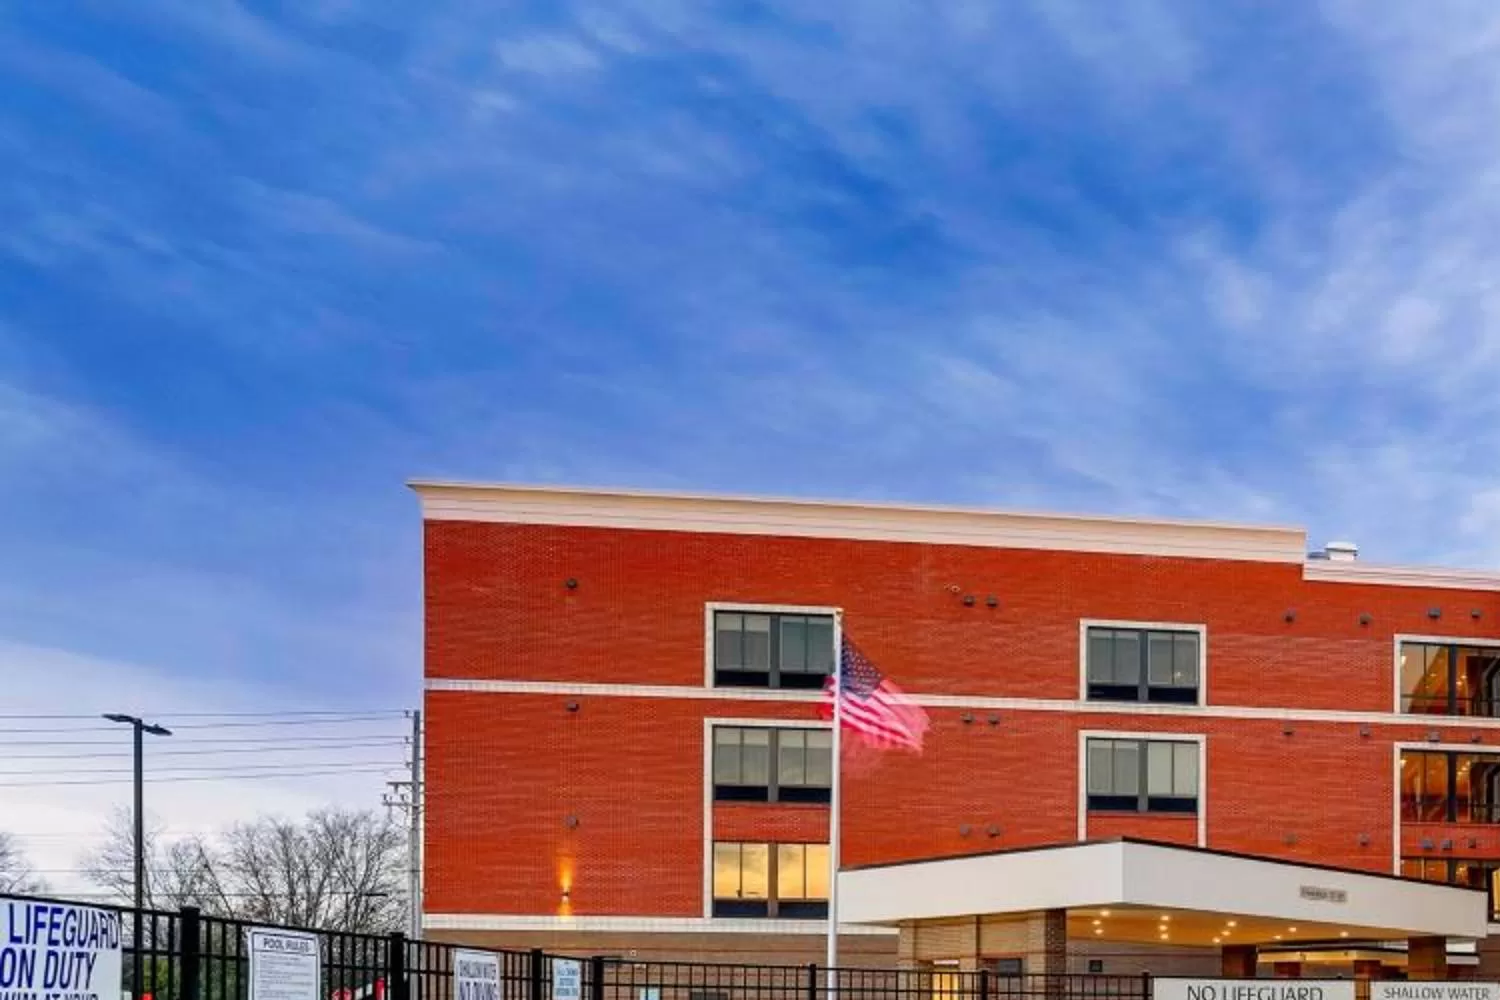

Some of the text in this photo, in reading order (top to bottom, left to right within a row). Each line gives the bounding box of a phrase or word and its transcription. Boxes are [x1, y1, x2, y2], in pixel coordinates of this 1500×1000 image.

[8, 903, 119, 949] LIFEGUARD
[0, 947, 97, 990] ON DUTY
[1383, 987, 1490, 1000] SHALLOW WATER
